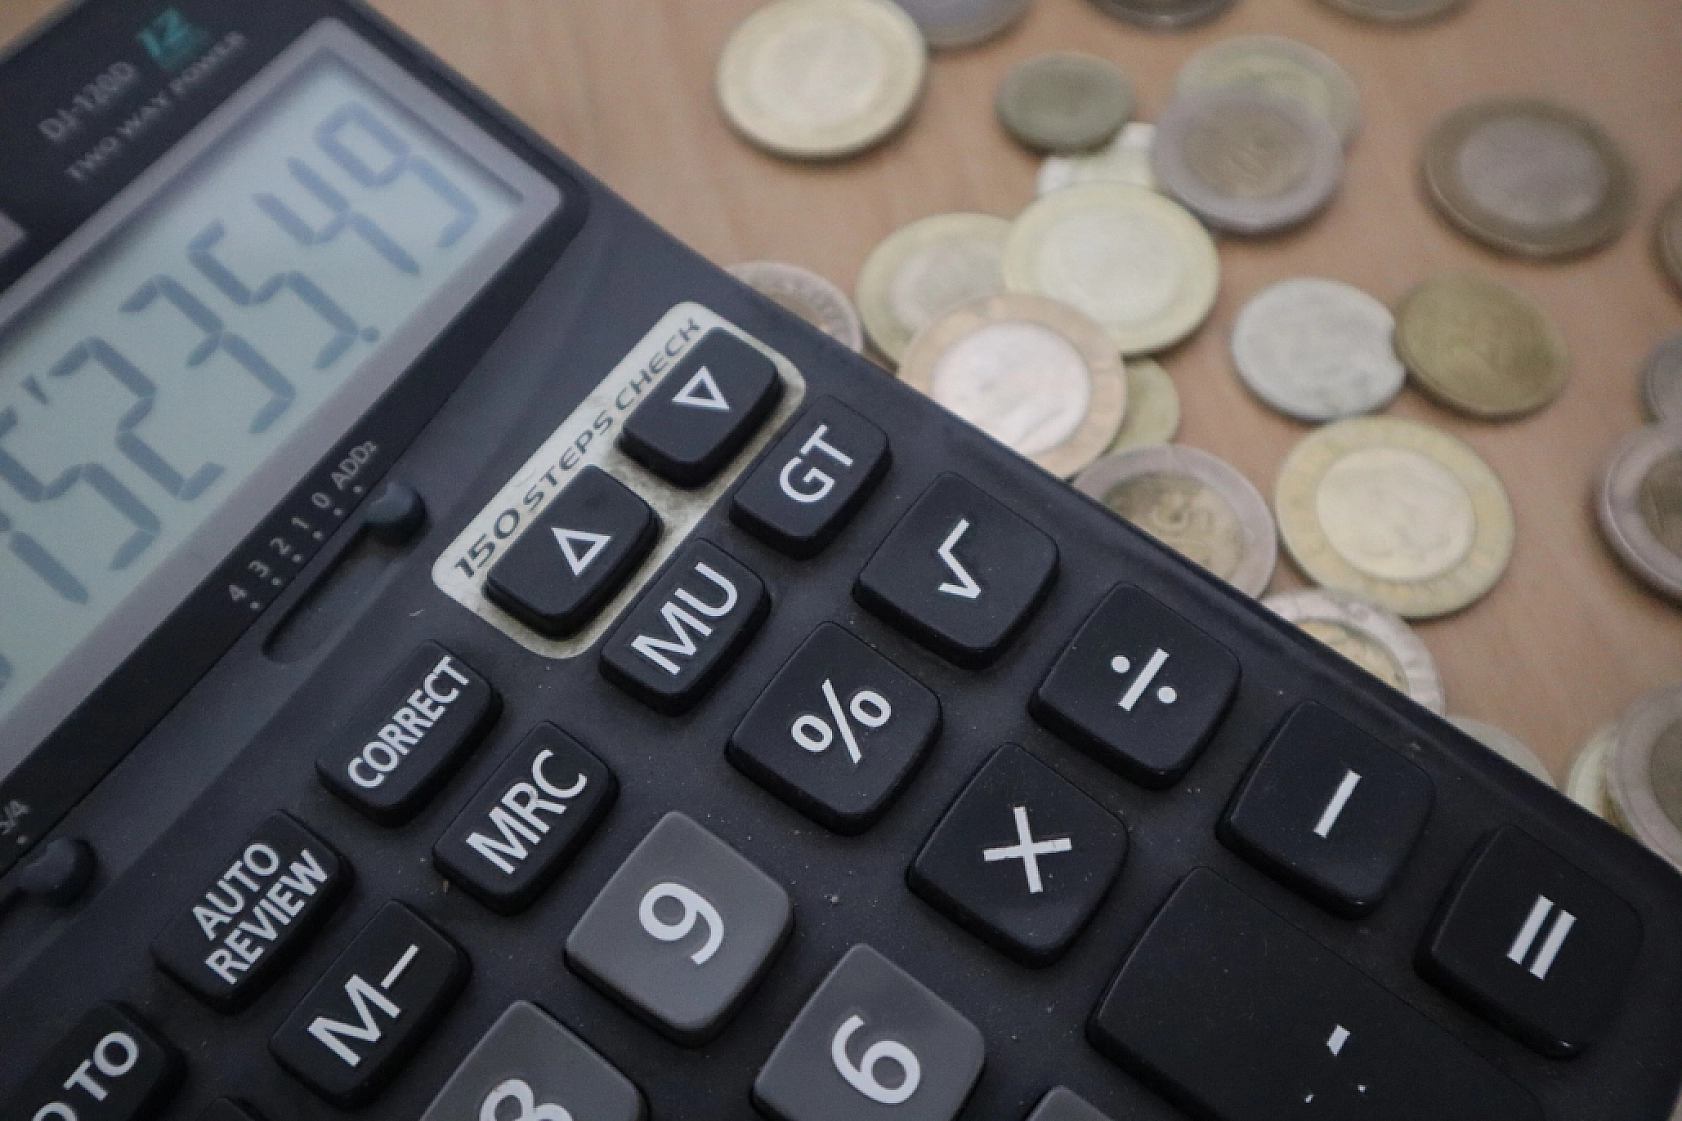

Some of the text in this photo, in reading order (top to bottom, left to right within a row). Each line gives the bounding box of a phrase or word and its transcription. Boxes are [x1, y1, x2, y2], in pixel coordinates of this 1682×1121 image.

[65, 136, 118, 182] TWO
[117, 91, 171, 136] WAY
[170, 31, 246, 96] POWER
[454, 316, 701, 579] 150 STEPS CHECK
[780, 424, 854, 503] GT
[229, 584, 248, 601] 4
[248, 560, 269, 578] 3
[269, 537, 291, 555] 2
[291, 517, 310, 530] 1
[311, 492, 331, 509] 0
[630, 562, 738, 676] MU
[347, 654, 470, 789] CORRECT
[465, 749, 588, 875] MRC
[192, 842, 280, 941] AUTO
[205, 849, 328, 985] REVIEW
[638, 881, 725, 965] 9
[63, 1031, 140, 1104] TO
[831, 1014, 921, 1104] 6
